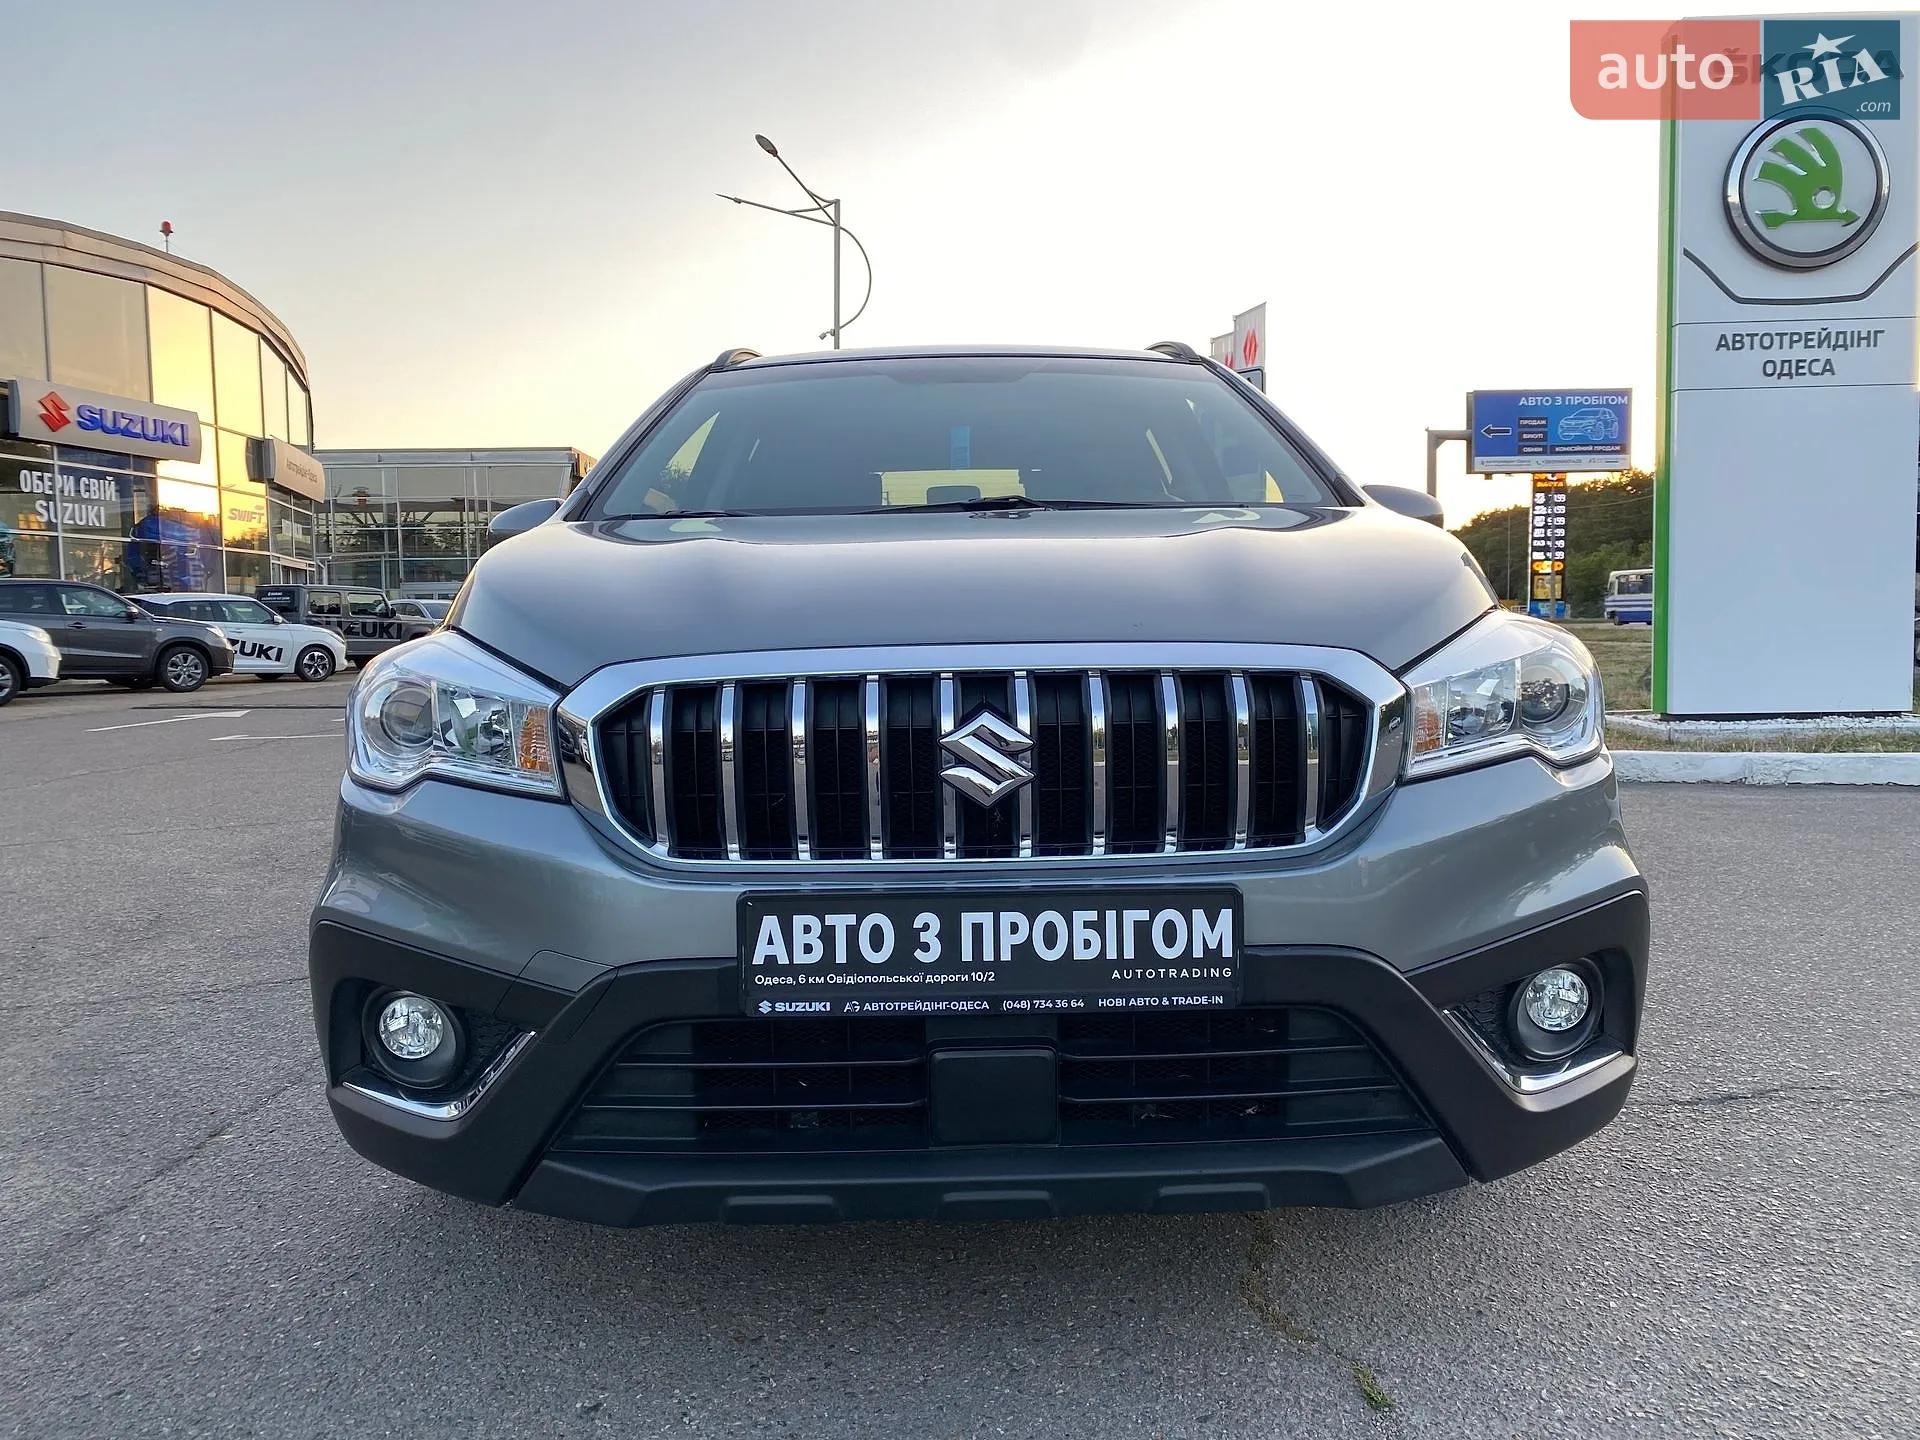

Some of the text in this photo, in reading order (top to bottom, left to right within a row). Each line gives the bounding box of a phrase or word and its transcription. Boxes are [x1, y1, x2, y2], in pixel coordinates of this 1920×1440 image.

[1715, 327, 1886, 352] АВТОТРЕЙДІНГ
[1762, 358, 1836, 380] ОДЕСА
[1518, 396, 1552, 407] АВТО
[1565, 395, 1629, 406] ПРОБІГОМ
[76, 403, 191, 448] SUZUKI
[19, 469, 116, 501] ОБЕРИ СВІЙ
[35, 499, 106, 528] SUZUKI
[228, 507, 265, 524] SWIFT
[751, 913, 895, 965] АВТО
[961, 908, 1234, 963] ПРОБІГОМ
[754, 971, 996, 986] Одеса, 6 км Овідіопольської дороги 10/2
[1111, 967, 1233, 980] AUTOTRADING
[775, 1002, 831, 1012] SUZUKI
[863, 999, 990, 1012] АВТОТРЕЙДІНГ-ОДЕСА
[1002, 999, 1085, 1011] (048) 734 36 64
[1098, 995, 1223, 1007] НОВІ АВТО & TRADE-IN
